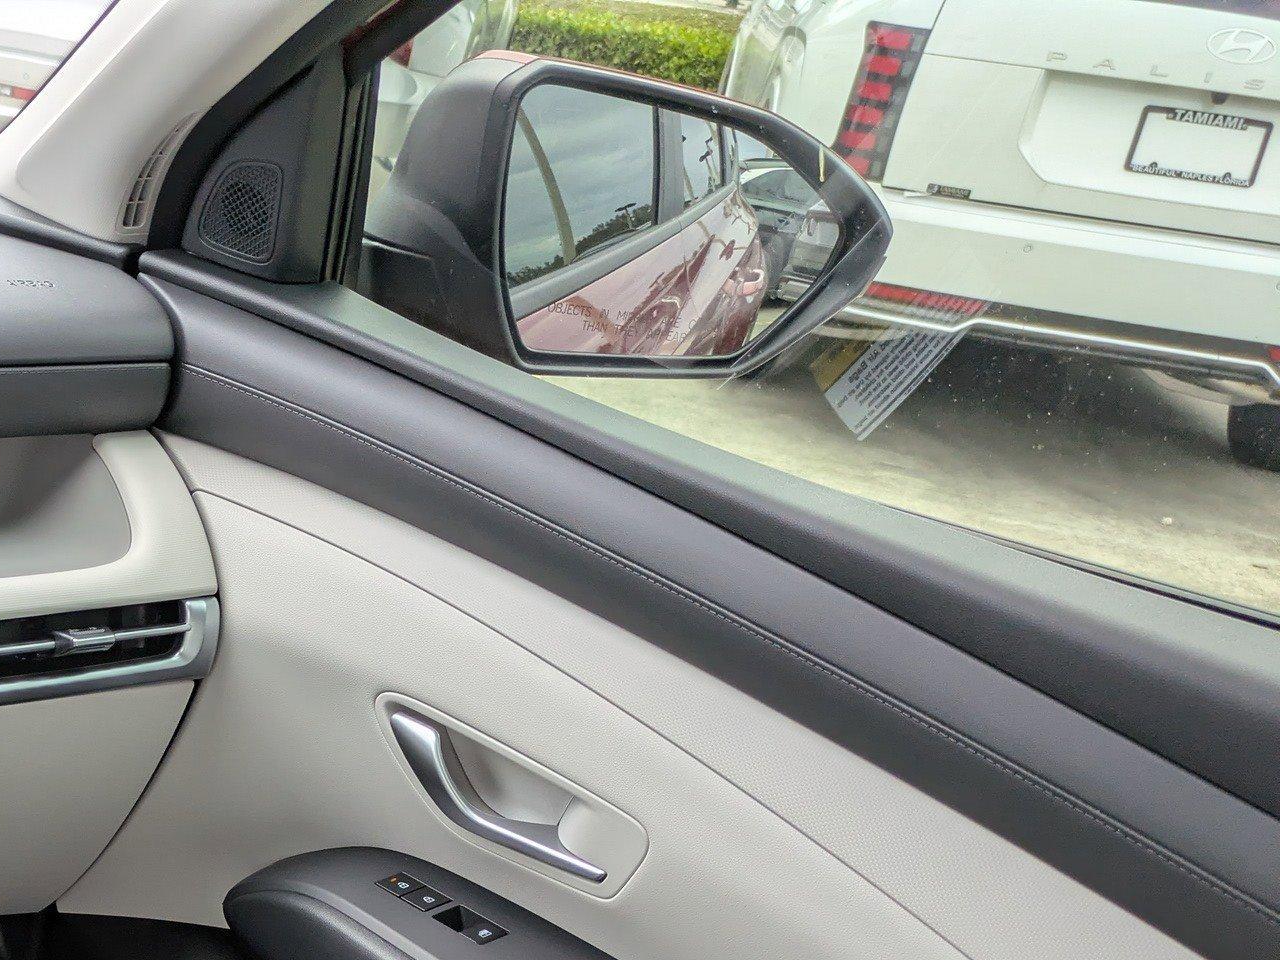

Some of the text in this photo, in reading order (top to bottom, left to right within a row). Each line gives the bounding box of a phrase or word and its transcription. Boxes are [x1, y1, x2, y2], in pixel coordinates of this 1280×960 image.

[1174, 109, 1246, 131] TAMIAMI
[1181, 170, 1213, 183] NAPLES
[1214, 175, 1251, 188] FLORIDA
[547, 302, 593, 318] OBJECTS
[582, 320, 608, 332] THAN
